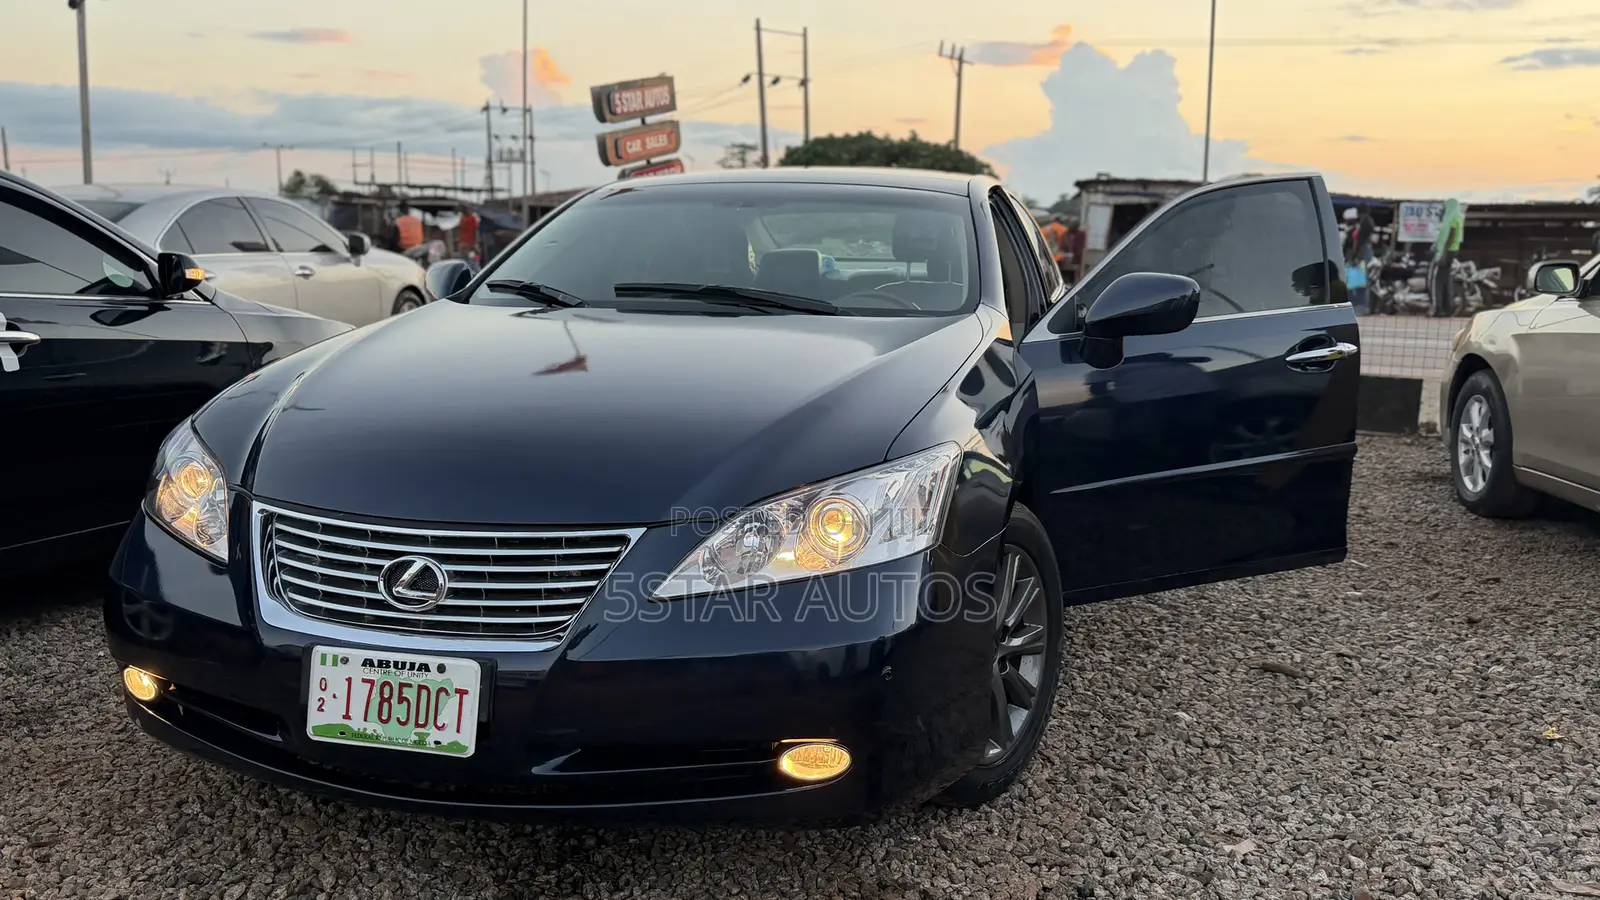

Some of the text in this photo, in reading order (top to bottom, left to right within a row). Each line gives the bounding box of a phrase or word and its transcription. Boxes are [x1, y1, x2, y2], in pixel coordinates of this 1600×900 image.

[614, 84, 670, 114] 5 STAR AUTOS
[625, 133, 669, 154] CAR SALES
[361, 658, 432, 673] ABUJA
[362, 667, 430, 681] CENTRE OF UNITY
[342, 677, 469, 734] 1785DCT
